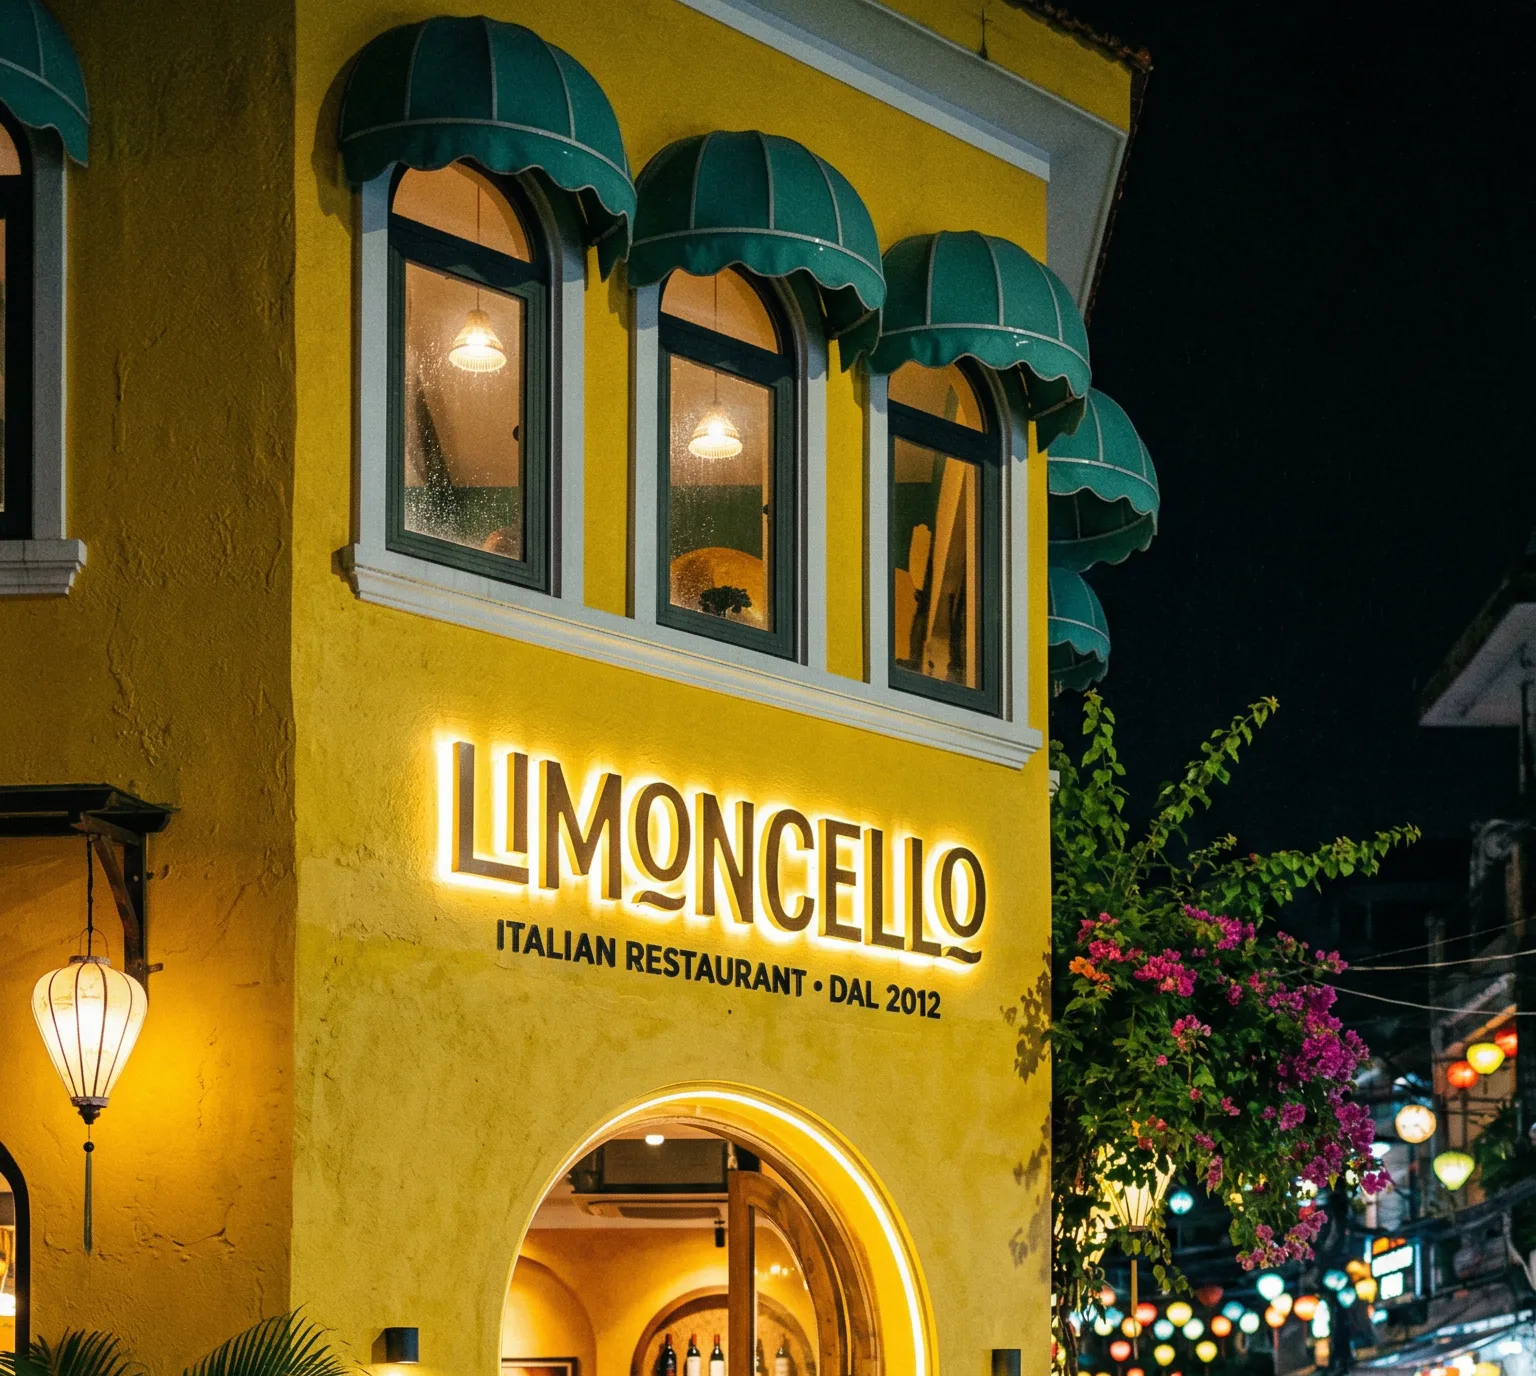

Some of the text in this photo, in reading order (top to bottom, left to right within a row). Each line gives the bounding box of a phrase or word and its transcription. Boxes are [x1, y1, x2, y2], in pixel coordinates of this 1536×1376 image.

[452, 741, 987, 963] LIMONCELLO
[497, 919, 616, 968] ITALIAN
[625, 940, 807, 997] RESTAURANT
[829, 974, 879, 1010] DAL
[886, 984, 941, 1019] 2012
